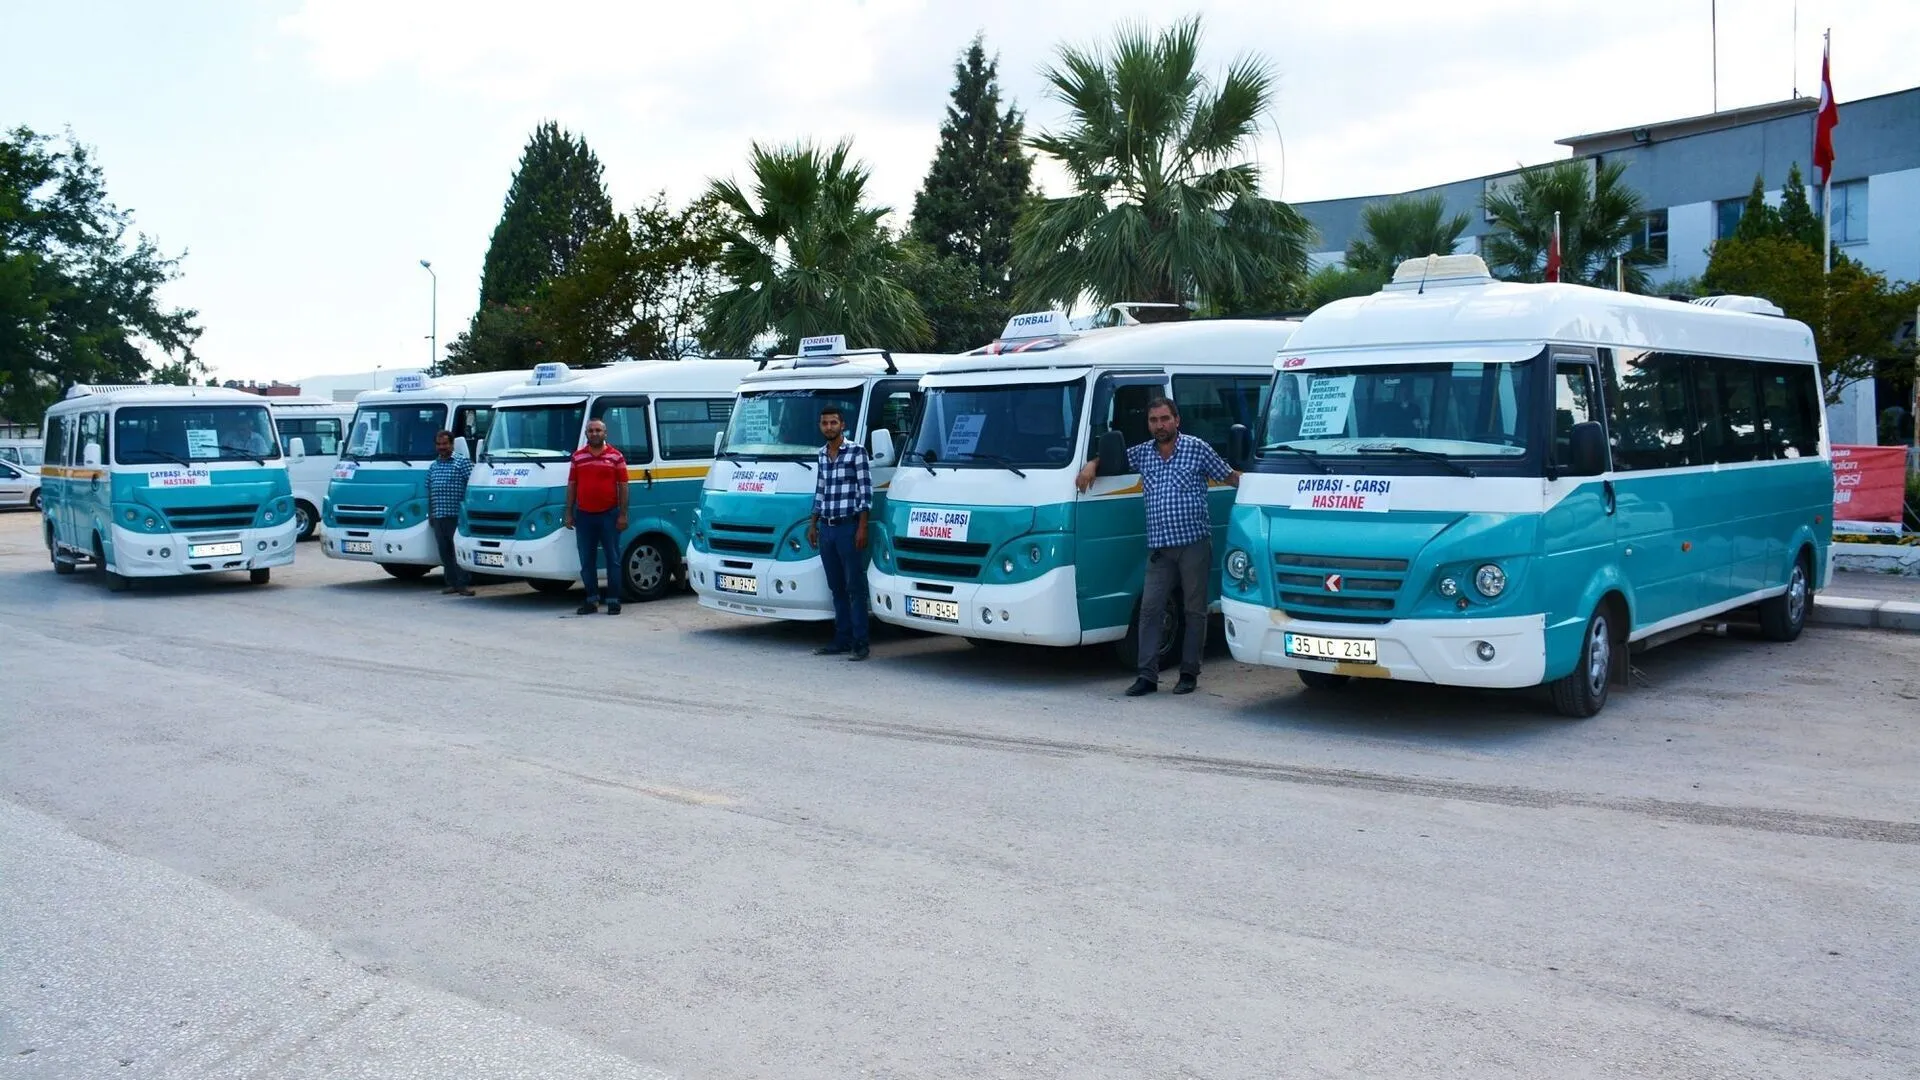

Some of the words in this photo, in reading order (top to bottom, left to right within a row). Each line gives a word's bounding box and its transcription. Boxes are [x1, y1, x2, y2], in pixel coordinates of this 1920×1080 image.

[1012, 315, 1053, 326] TORBALI
[802, 336, 838, 345] TORBALI
[163, 478, 196, 486] HASTANE
[759, 471, 779, 482] ÇARŞI
[1833, 471, 1863, 489] yesi
[737, 482, 765, 492] HASTANE
[1297, 479, 1343, 494] ÇAYBAŞI
[1353, 480, 1391, 495] ÇARŞI
[1312, 495, 1366, 509] HASTANE
[910, 511, 939, 525] ÇAYBAŞI
[944, 513, 968, 527] ÇARŞI
[920, 526, 953, 538] HASTANE
[740, 578, 756, 591] 9474
[911, 598, 920, 612] 35
[925, 601, 931, 614] M
[936, 603, 956, 617] 9454
[1295, 637, 1311, 653] 35
[1317, 639, 1335, 656] LC
[1344, 642, 1371, 658] 234
